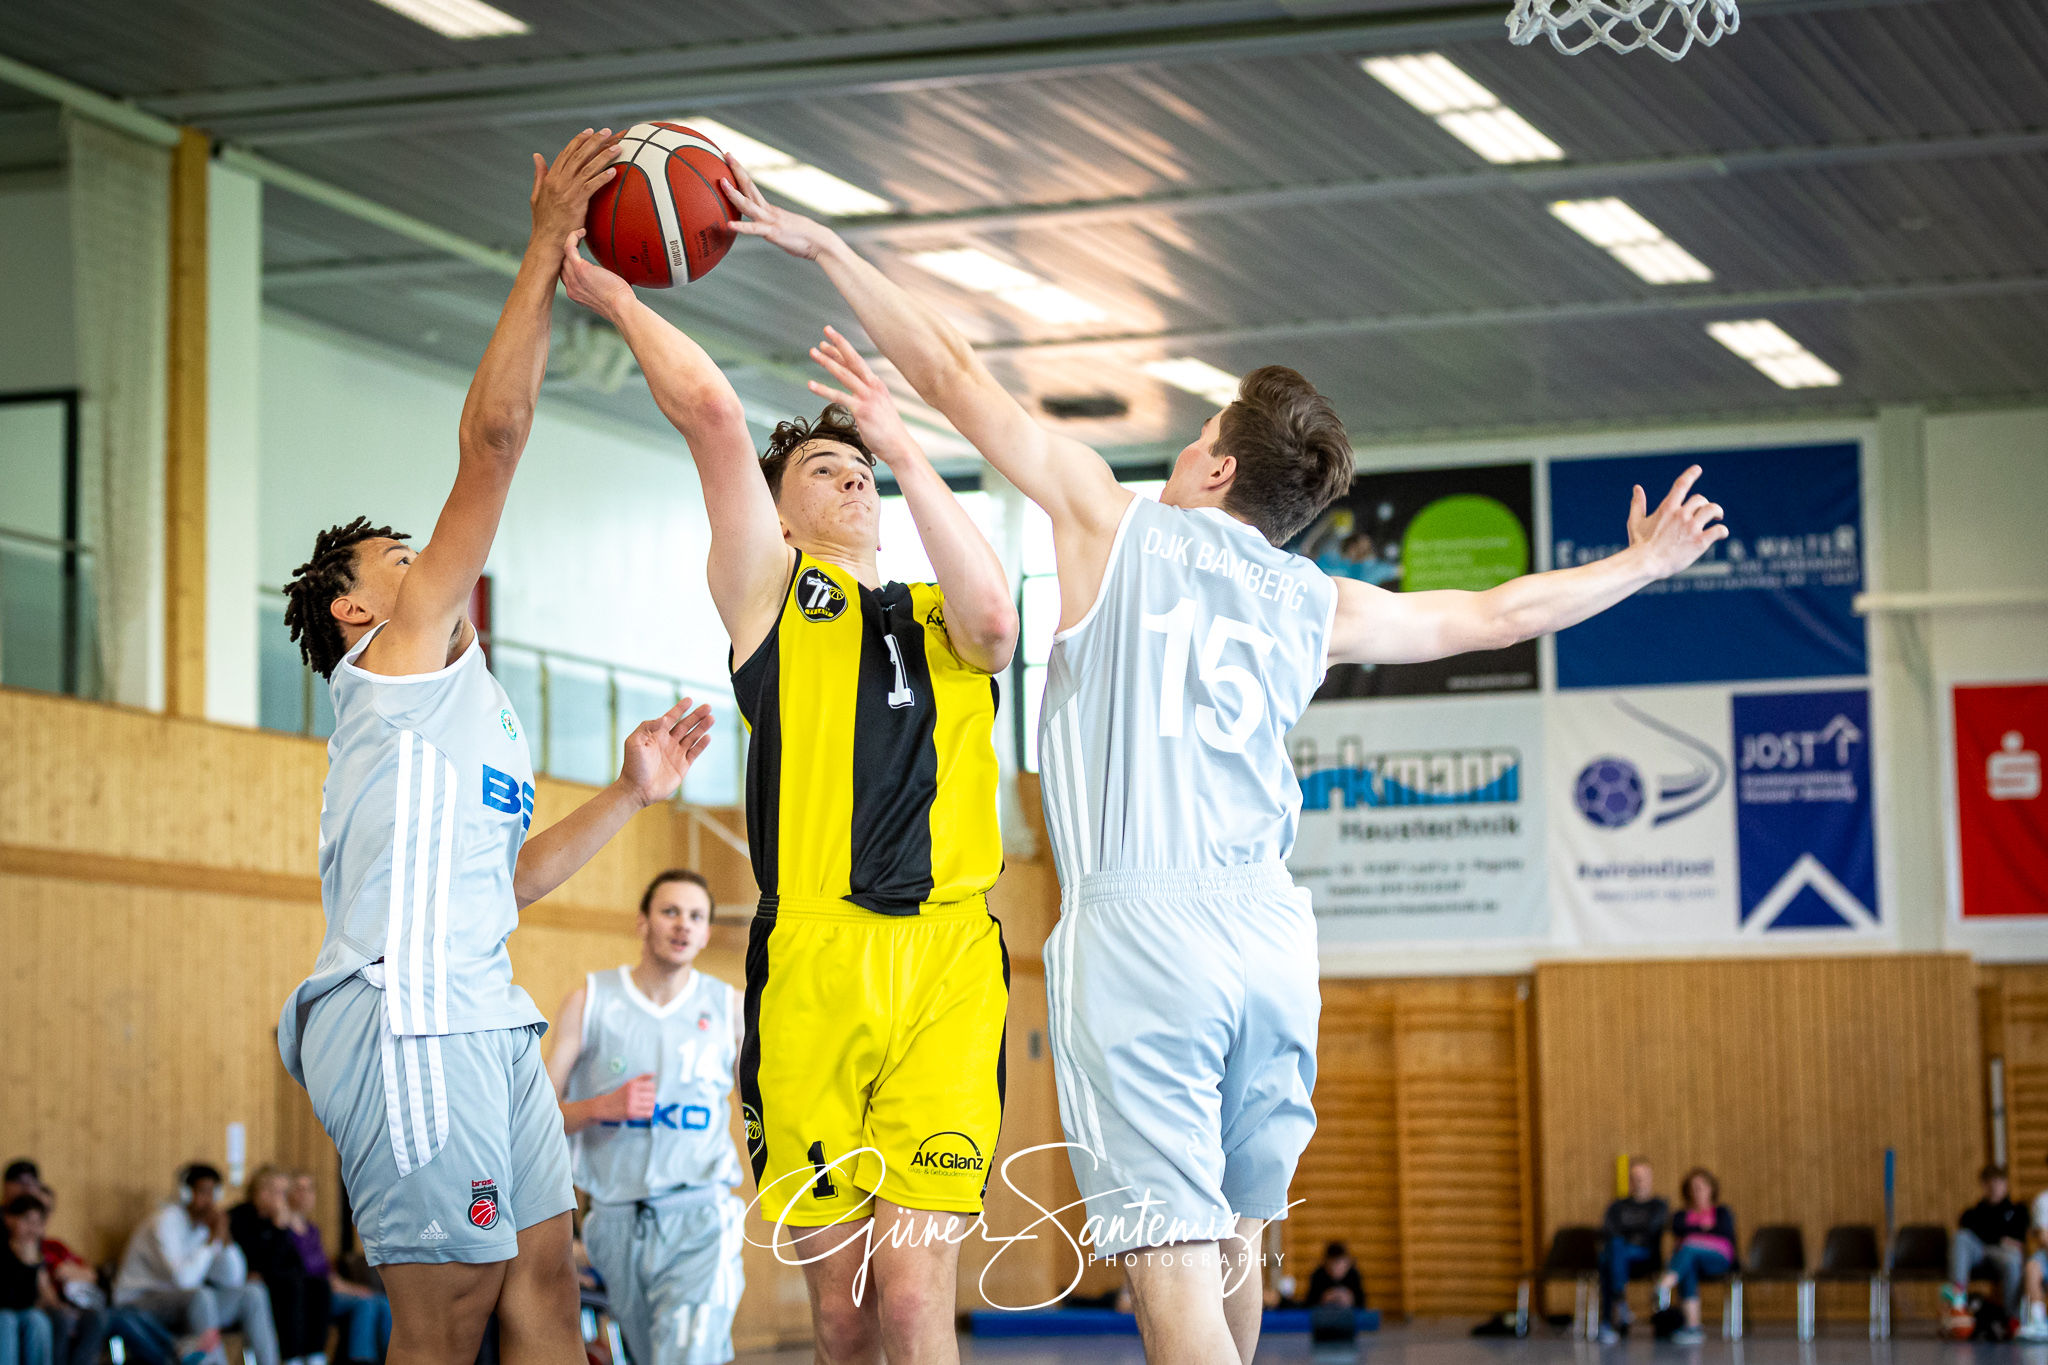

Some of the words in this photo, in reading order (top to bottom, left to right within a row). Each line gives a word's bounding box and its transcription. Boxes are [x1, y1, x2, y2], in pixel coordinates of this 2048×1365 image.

[1143, 526, 1194, 567] DJK
[1195, 541, 1309, 612] BAMBERG
[884, 634, 914, 709] 1
[1141, 596, 1277, 754] 15
[1741, 731, 1820, 770] JOST
[807, 1140, 838, 1201] 1
[420, 1231, 448, 1240] adidas
